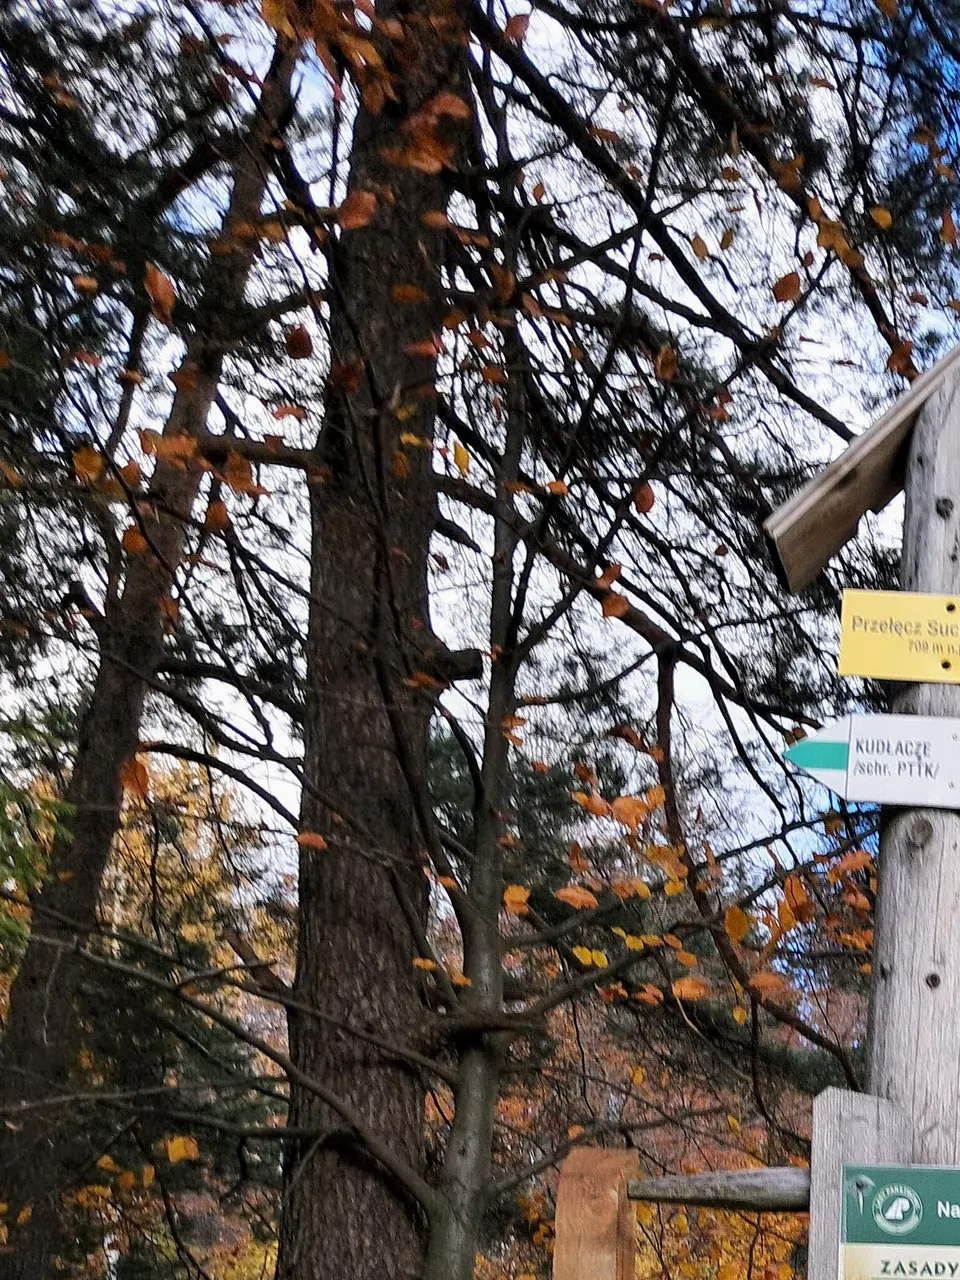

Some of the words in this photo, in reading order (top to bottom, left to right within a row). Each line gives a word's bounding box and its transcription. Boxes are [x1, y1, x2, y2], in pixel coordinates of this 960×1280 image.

[852, 615, 922, 637] Przełęcz
[908, 639, 929, 654] 709
[932, 643, 944, 654] m
[855, 738, 932, 757] KUDŁACZE
[853, 760, 892, 777] /schr.
[896, 762, 940, 780] PTTK/
[881, 1259, 959, 1277] ZASADY
